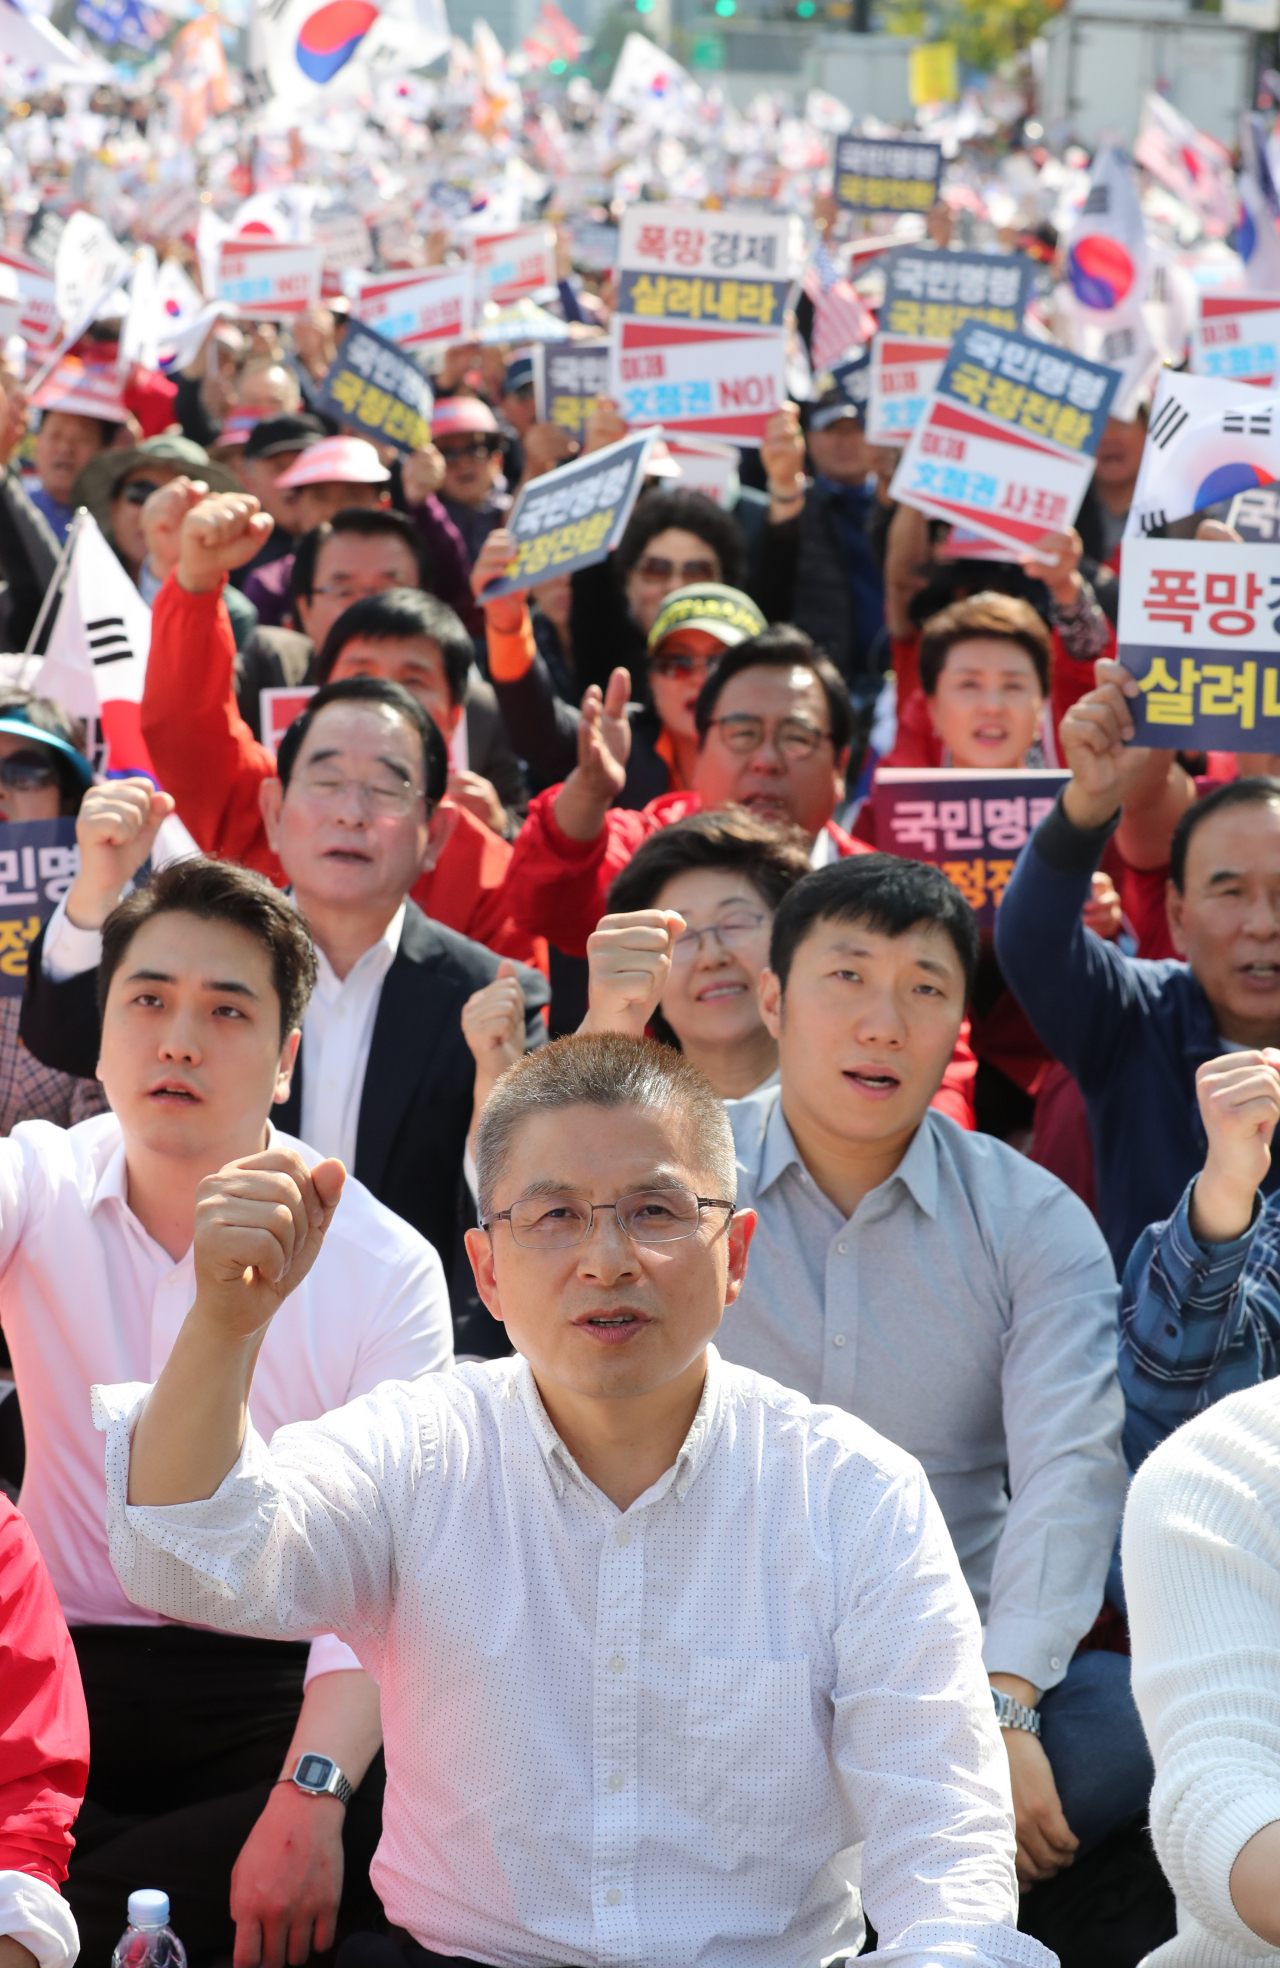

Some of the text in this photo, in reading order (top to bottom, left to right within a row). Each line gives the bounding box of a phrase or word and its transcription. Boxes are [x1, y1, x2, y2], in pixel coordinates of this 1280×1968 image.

[636, 225, 777, 269] 폭망경제
[630, 274, 777, 325] 살려내라
[719, 375, 775, 409] NO!
[963, 329, 1109, 410] 국민명령
[951, 362, 1094, 451] 국정전환
[517, 458, 633, 535] 국민명령
[1143, 568, 1280, 637] 폭망
